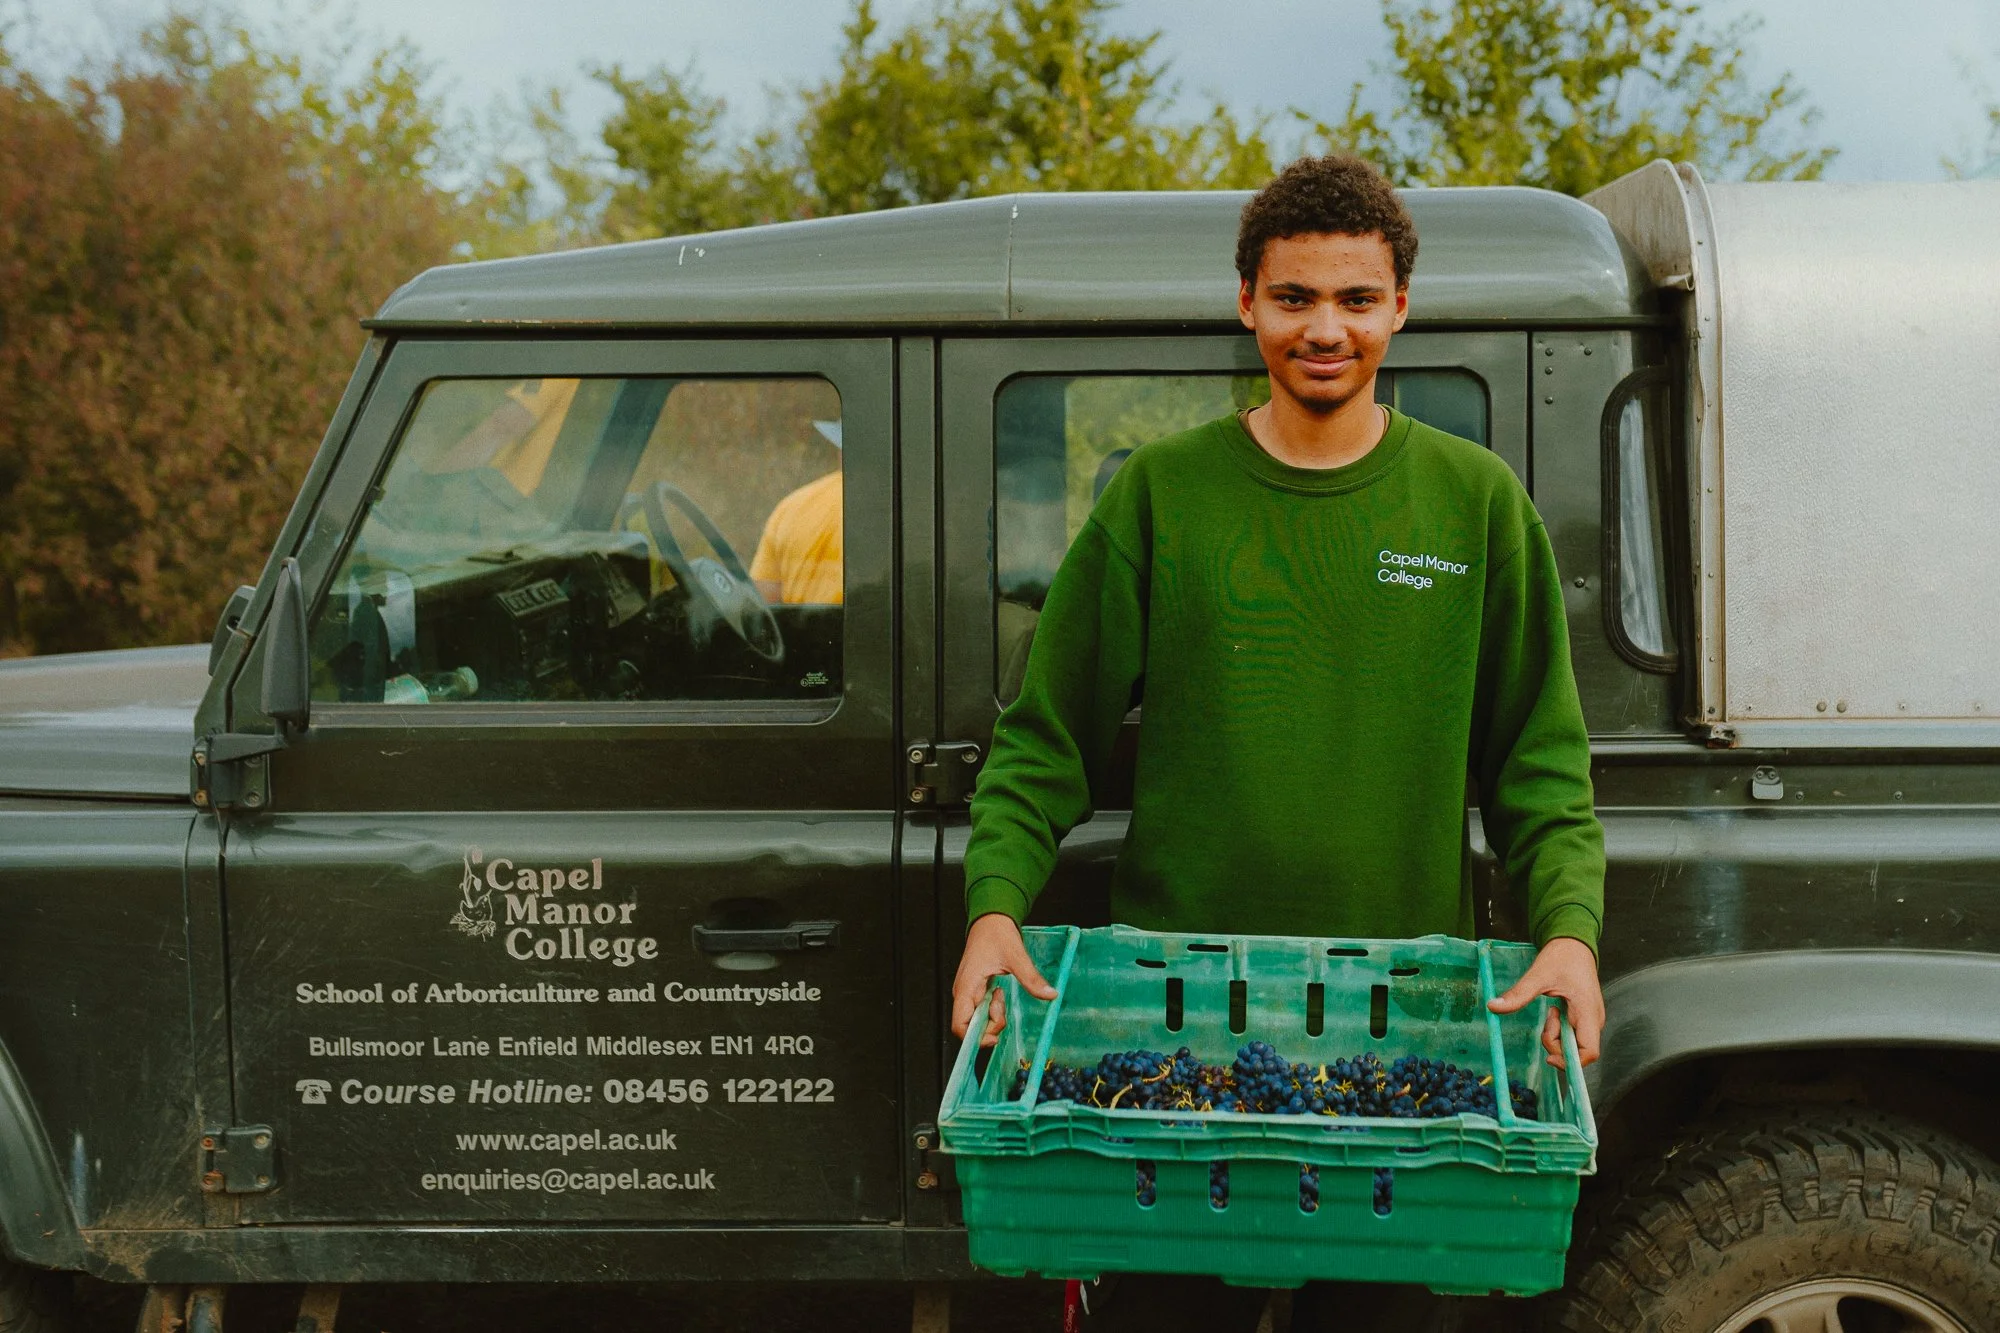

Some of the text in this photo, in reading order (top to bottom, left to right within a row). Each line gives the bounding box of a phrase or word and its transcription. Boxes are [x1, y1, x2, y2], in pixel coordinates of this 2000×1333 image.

[1379, 550, 1468, 575] Capel Manor
[1377, 568, 1433, 589] College
[486, 858, 602, 897] Capel
[504, 895, 636, 925] Manor
[506, 928, 659, 967] College
[296, 981, 821, 1006] School of Arboriculture and Countryside
[309, 1035, 814, 1057] Bullsmoor Lane Enfield Middlesex EN1 4RQ
[340, 1078, 835, 1104] Course Hotline: 08456 122122
[456, 1129, 677, 1156] www.capel.ac.uk
[421, 1169, 715, 1196] enquiries@capel.ac.uk
